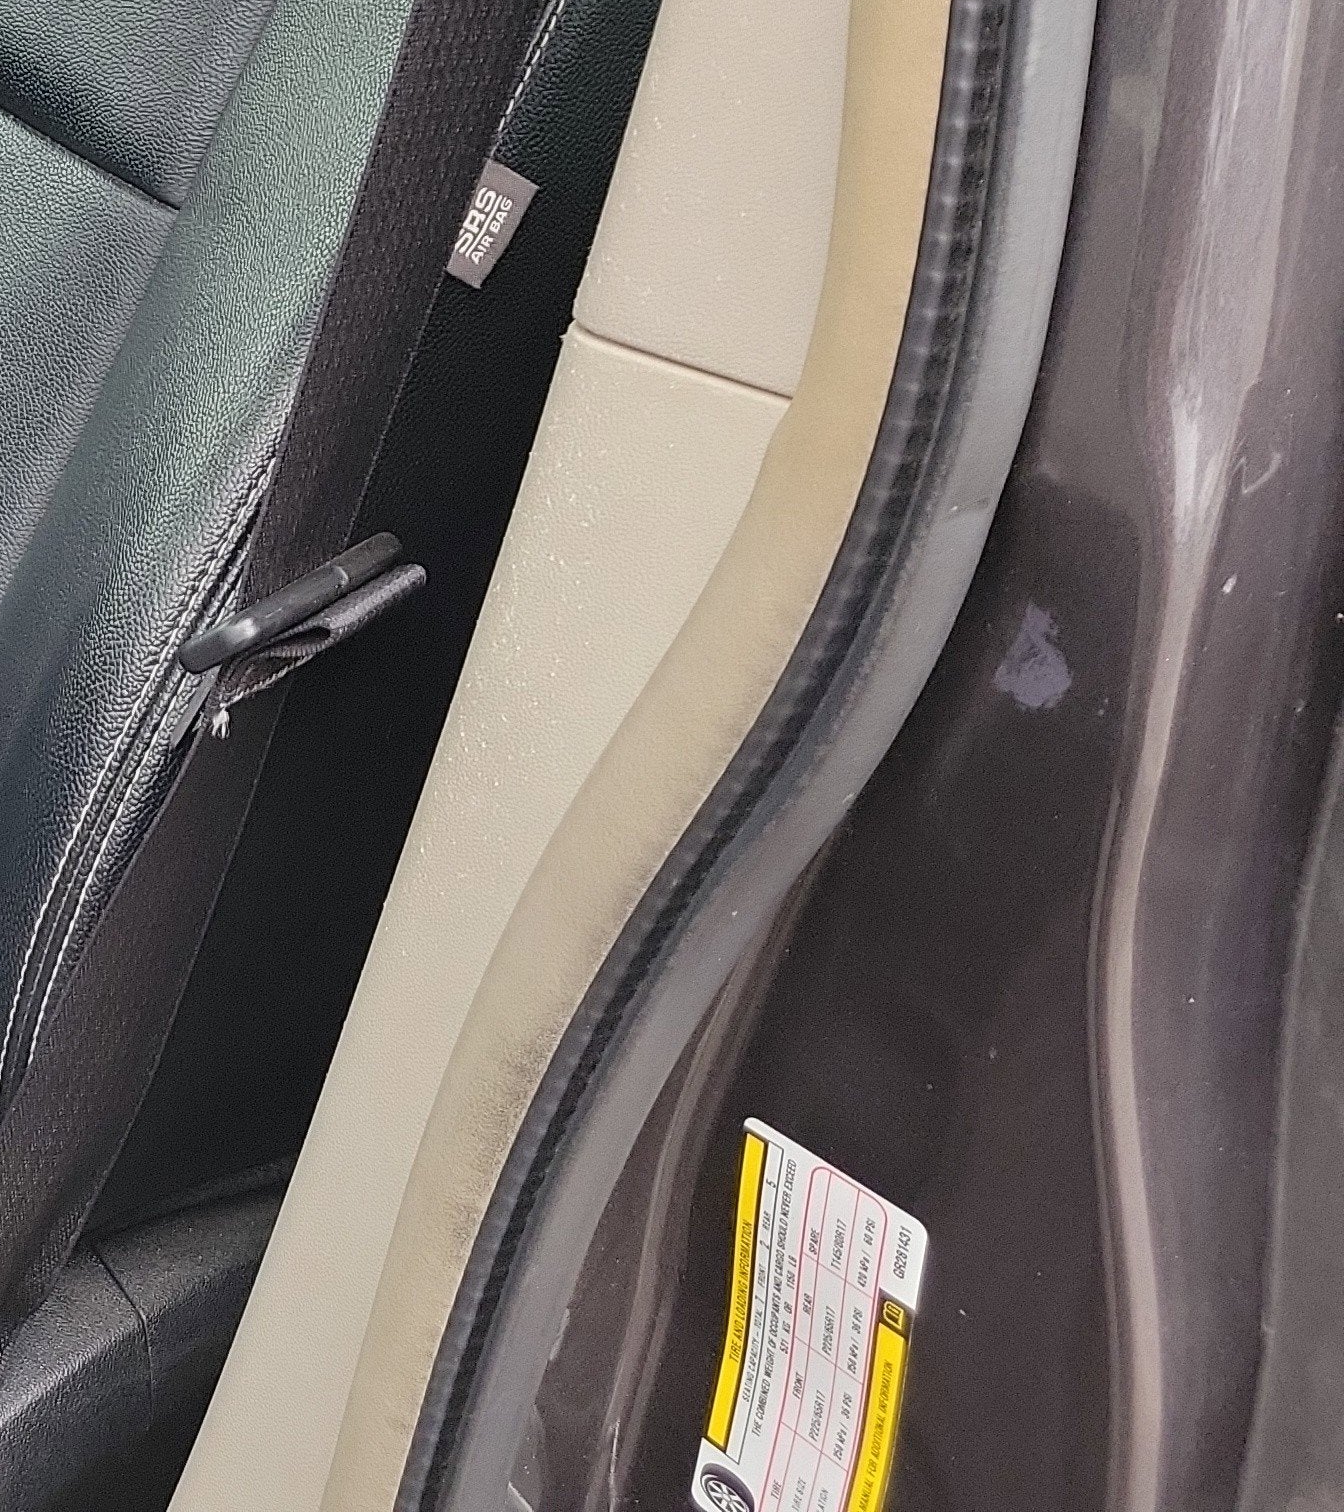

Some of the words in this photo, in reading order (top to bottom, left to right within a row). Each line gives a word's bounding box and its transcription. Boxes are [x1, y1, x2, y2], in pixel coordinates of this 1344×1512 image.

[454, 187, 497, 254] SRS
[471, 235, 493, 265] AIR
[489, 196, 513, 234] BAG
[765, 1177, 777, 1189] 5
[783, 1158, 797, 1191] EXCEED
[780, 1190, 793, 1220] NEVER
[739, 1219, 753, 1280] INFORMATION
[776, 1218, 788, 1250] SHOULD
[774, 1248, 785, 1277] CARGO
[892, 1225, 913, 1280] GR281431
[736, 1280, 749, 1321] LOADING
[733, 1318, 745, 1342] AND
[728, 1338, 743, 1363] TIRE
[751, 1417, 763, 1437] THE
[770, 1479, 782, 1500] TIRE
[792, 1371, 804, 1400] FRONT
